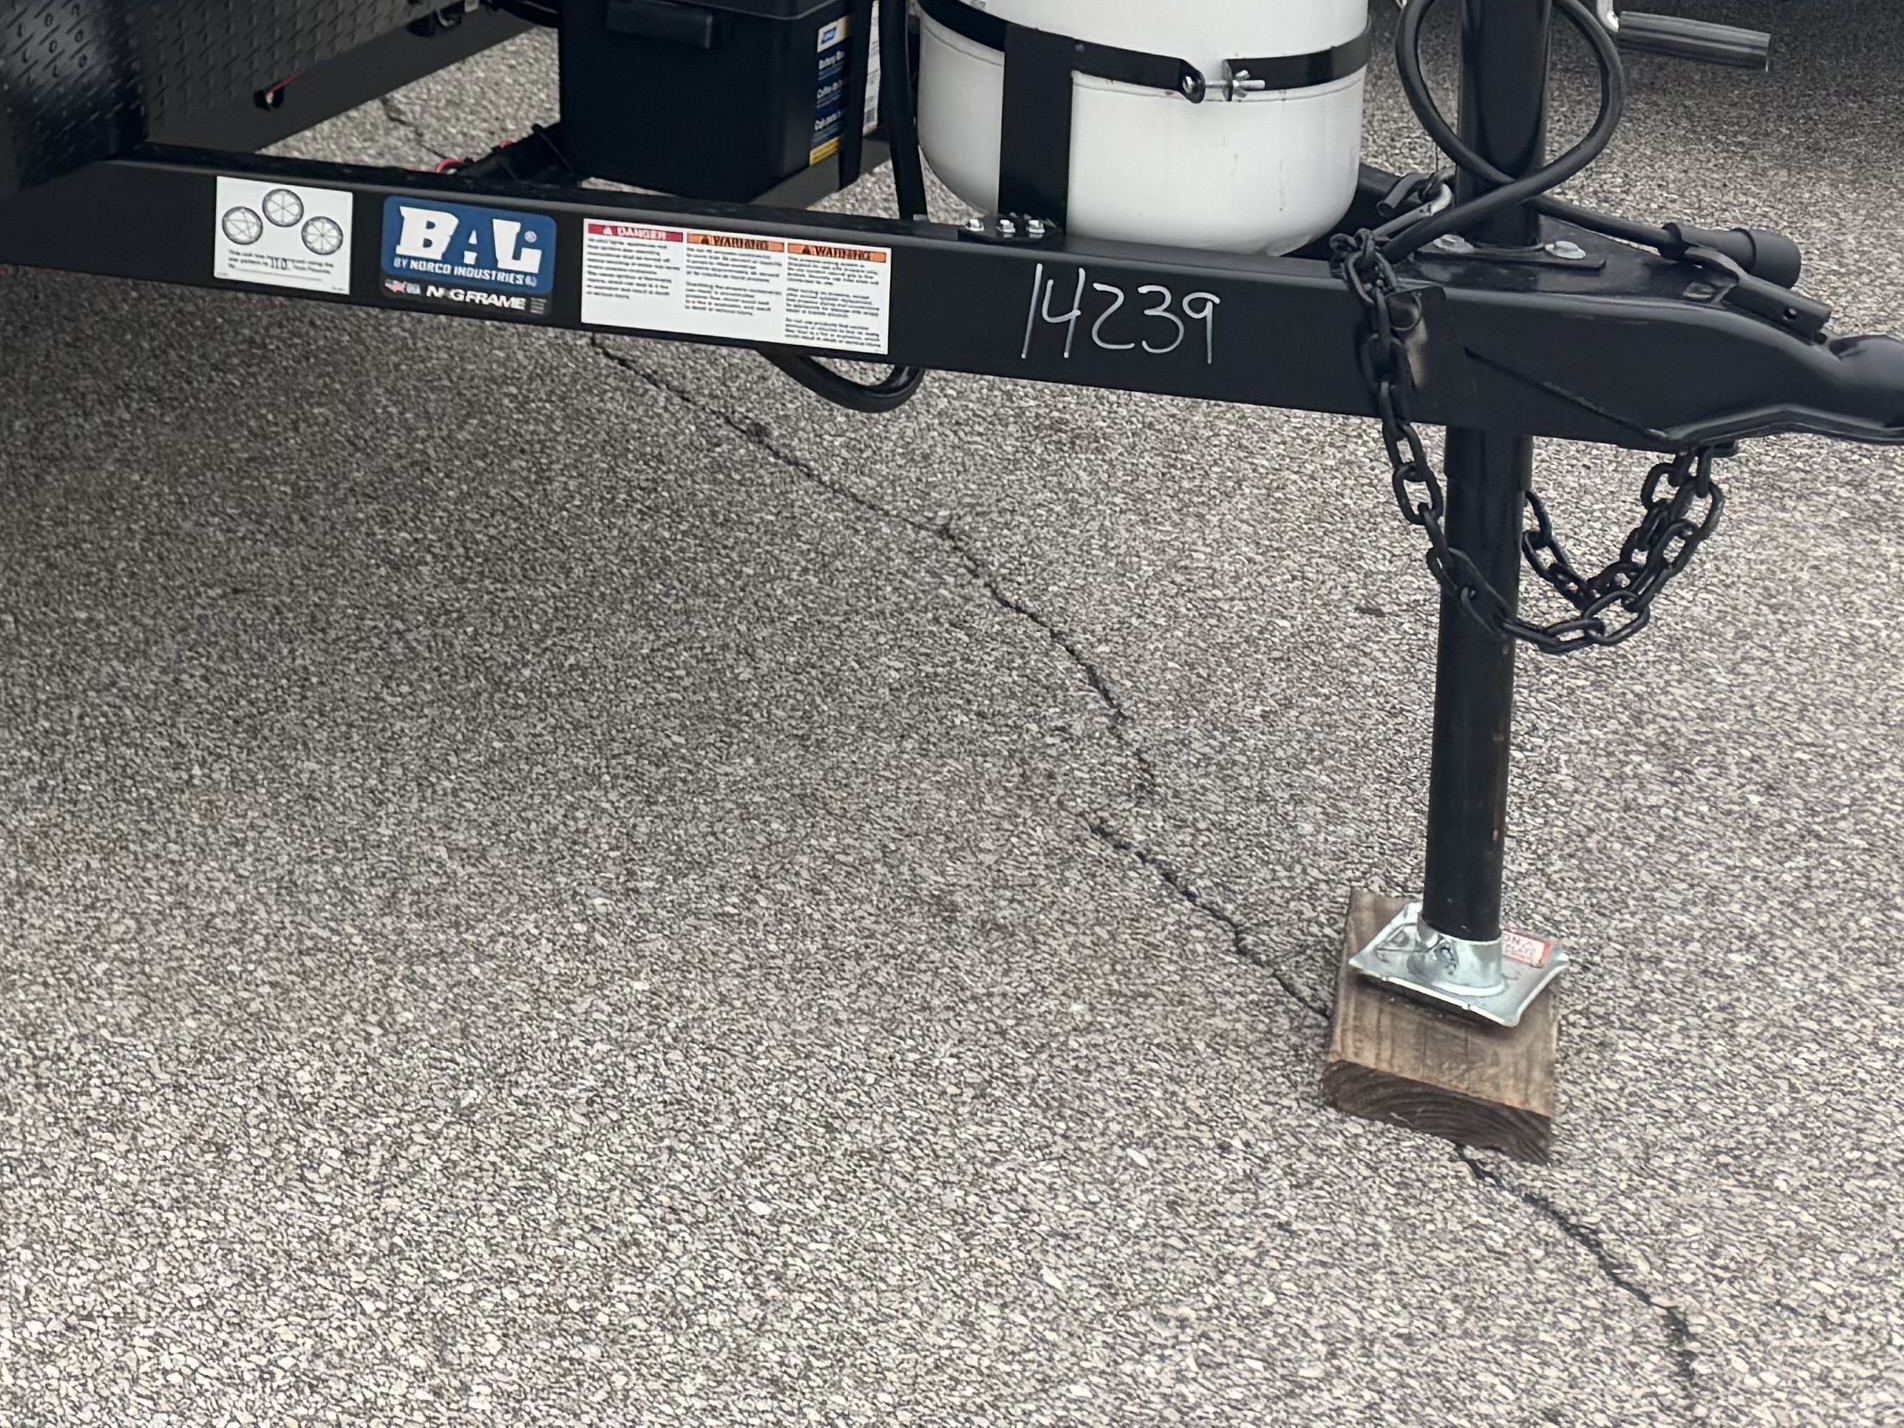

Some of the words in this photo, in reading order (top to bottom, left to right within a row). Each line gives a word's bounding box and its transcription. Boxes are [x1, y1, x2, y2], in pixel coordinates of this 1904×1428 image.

[395, 205, 542, 274] BAL
[616, 227, 667, 240] DANGER
[712, 235, 770, 251] WARNING
[814, 246, 871, 261] WARNING
[393, 257, 408, 269] BY
[409, 260, 453, 274] NORCO
[453, 265, 525, 286] INDUSTRIES
[1021, 262, 1221, 364] 14239
